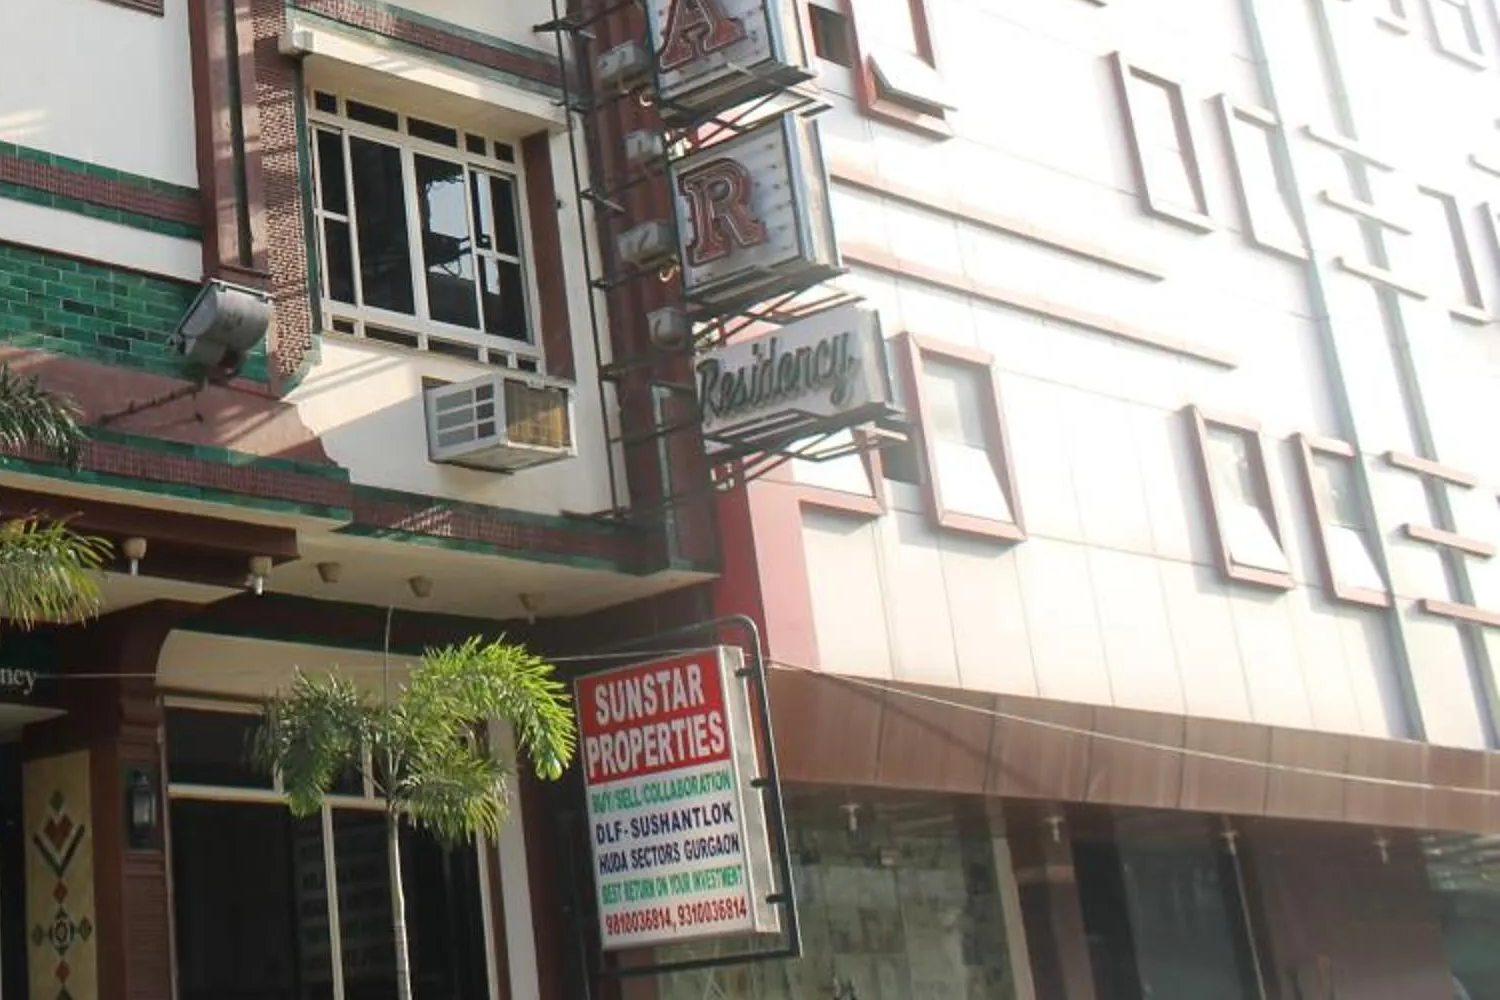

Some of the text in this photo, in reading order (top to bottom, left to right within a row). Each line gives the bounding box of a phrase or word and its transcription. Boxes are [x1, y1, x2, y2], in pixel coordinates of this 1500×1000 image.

[695, 331, 862, 427] Residency
[594, 663, 705, 726] SUNSTAR
[585, 710, 726, 780] PROPERTIES
[644, 770, 732, 804] COLLABORATION
[630, 843, 681, 869] SECTORS
[683, 833, 740, 860] GURGAON
